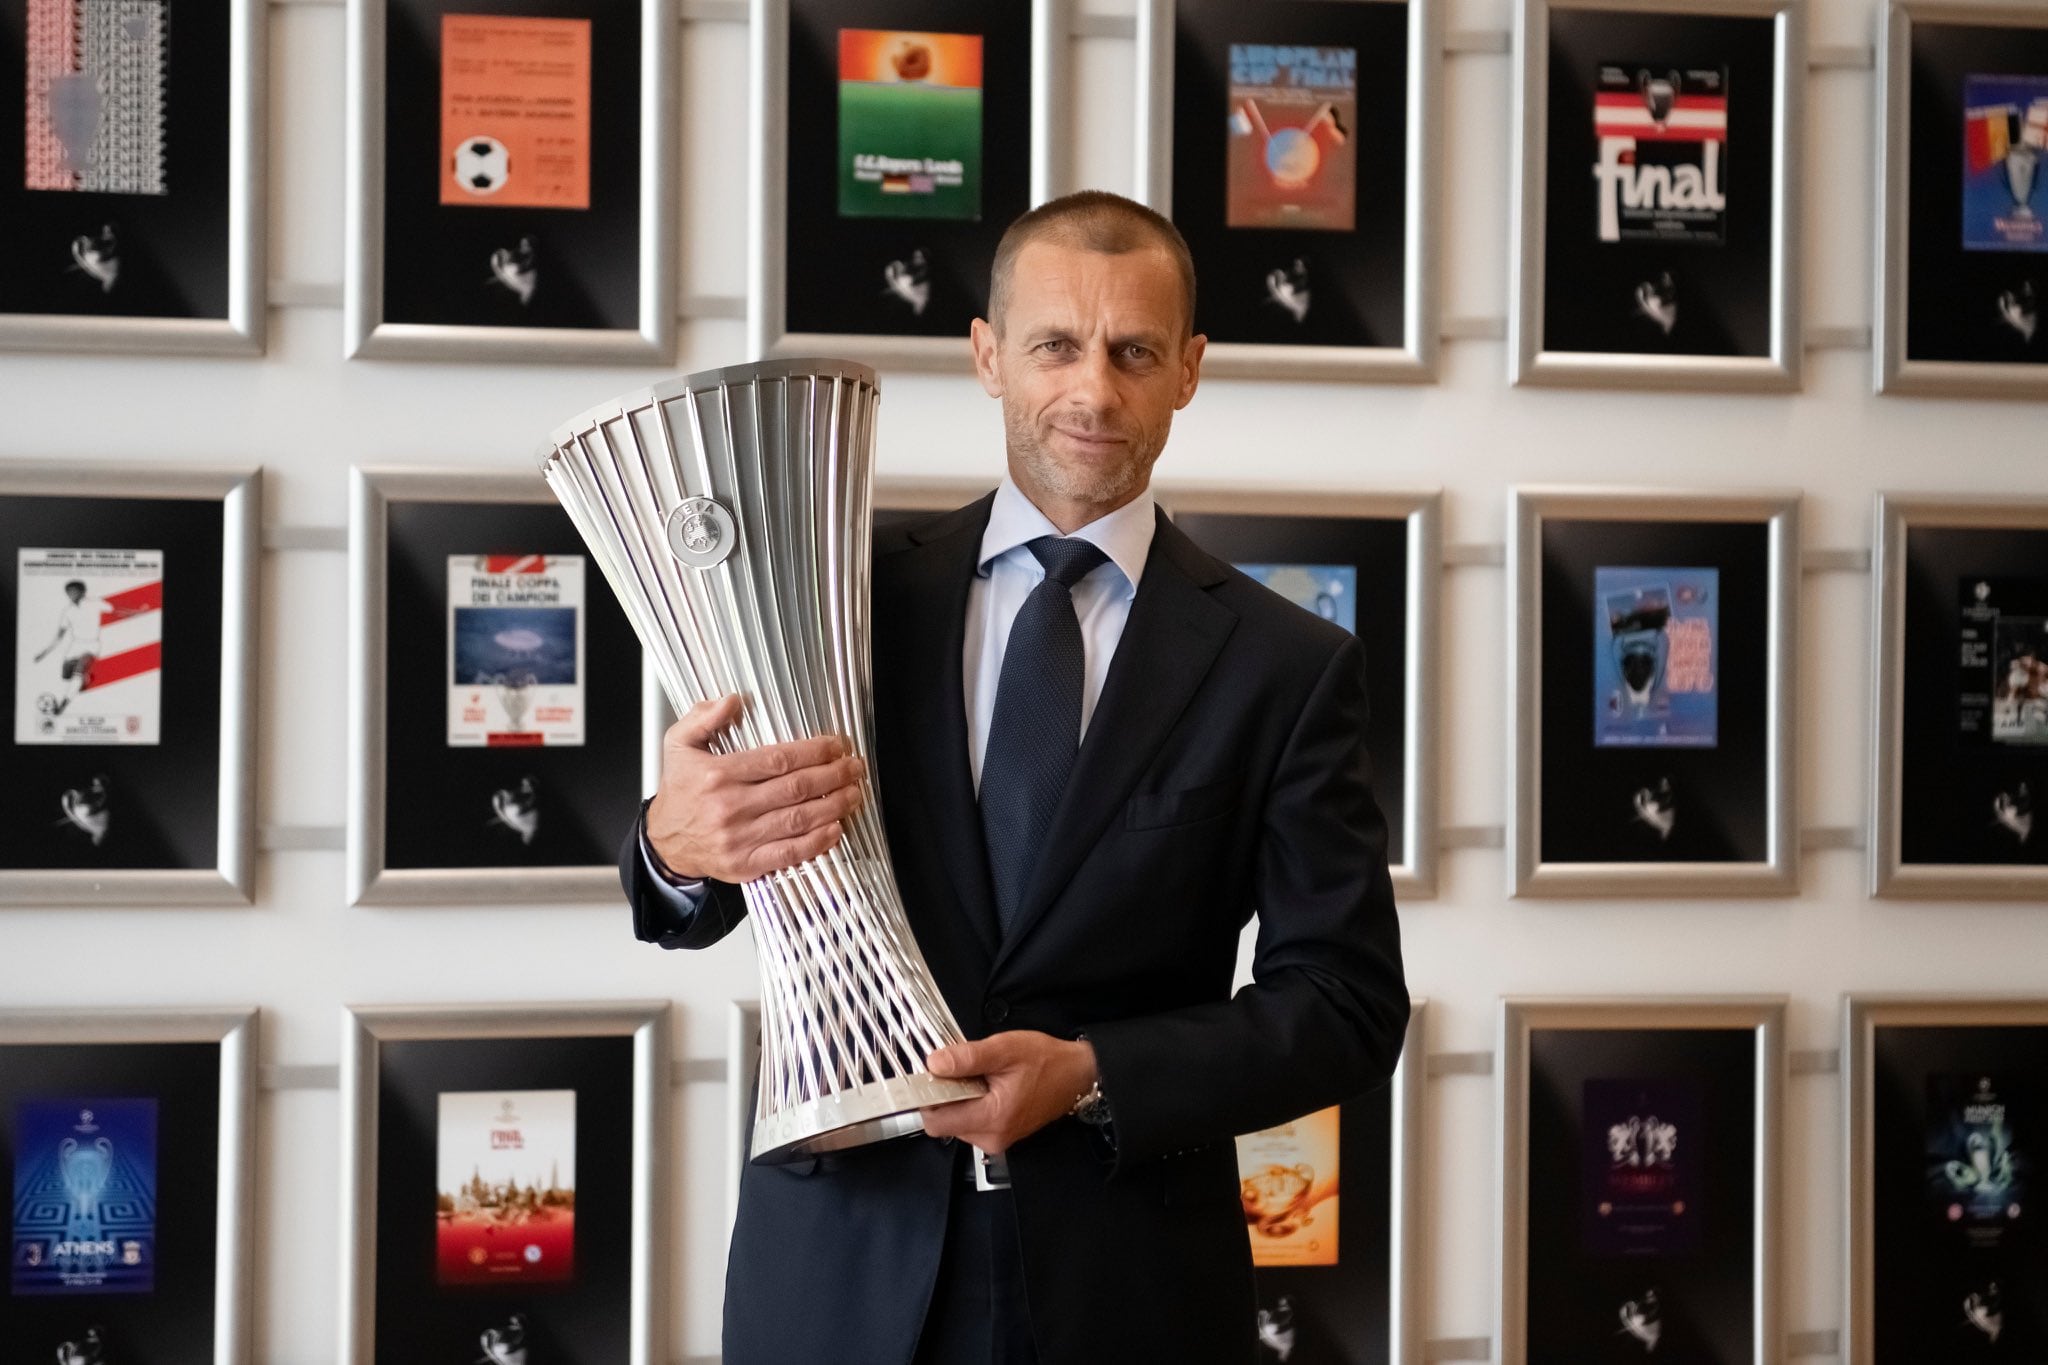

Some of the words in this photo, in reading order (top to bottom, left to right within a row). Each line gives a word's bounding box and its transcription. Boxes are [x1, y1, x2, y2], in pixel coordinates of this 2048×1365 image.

[1593, 137, 1725, 241] final
[672, 501, 714, 522] UEFA
[471, 577, 511, 588] FINALE
[496, 589, 560, 602] CAMPIONI
[54, 1241, 115, 1256] ATHENS
